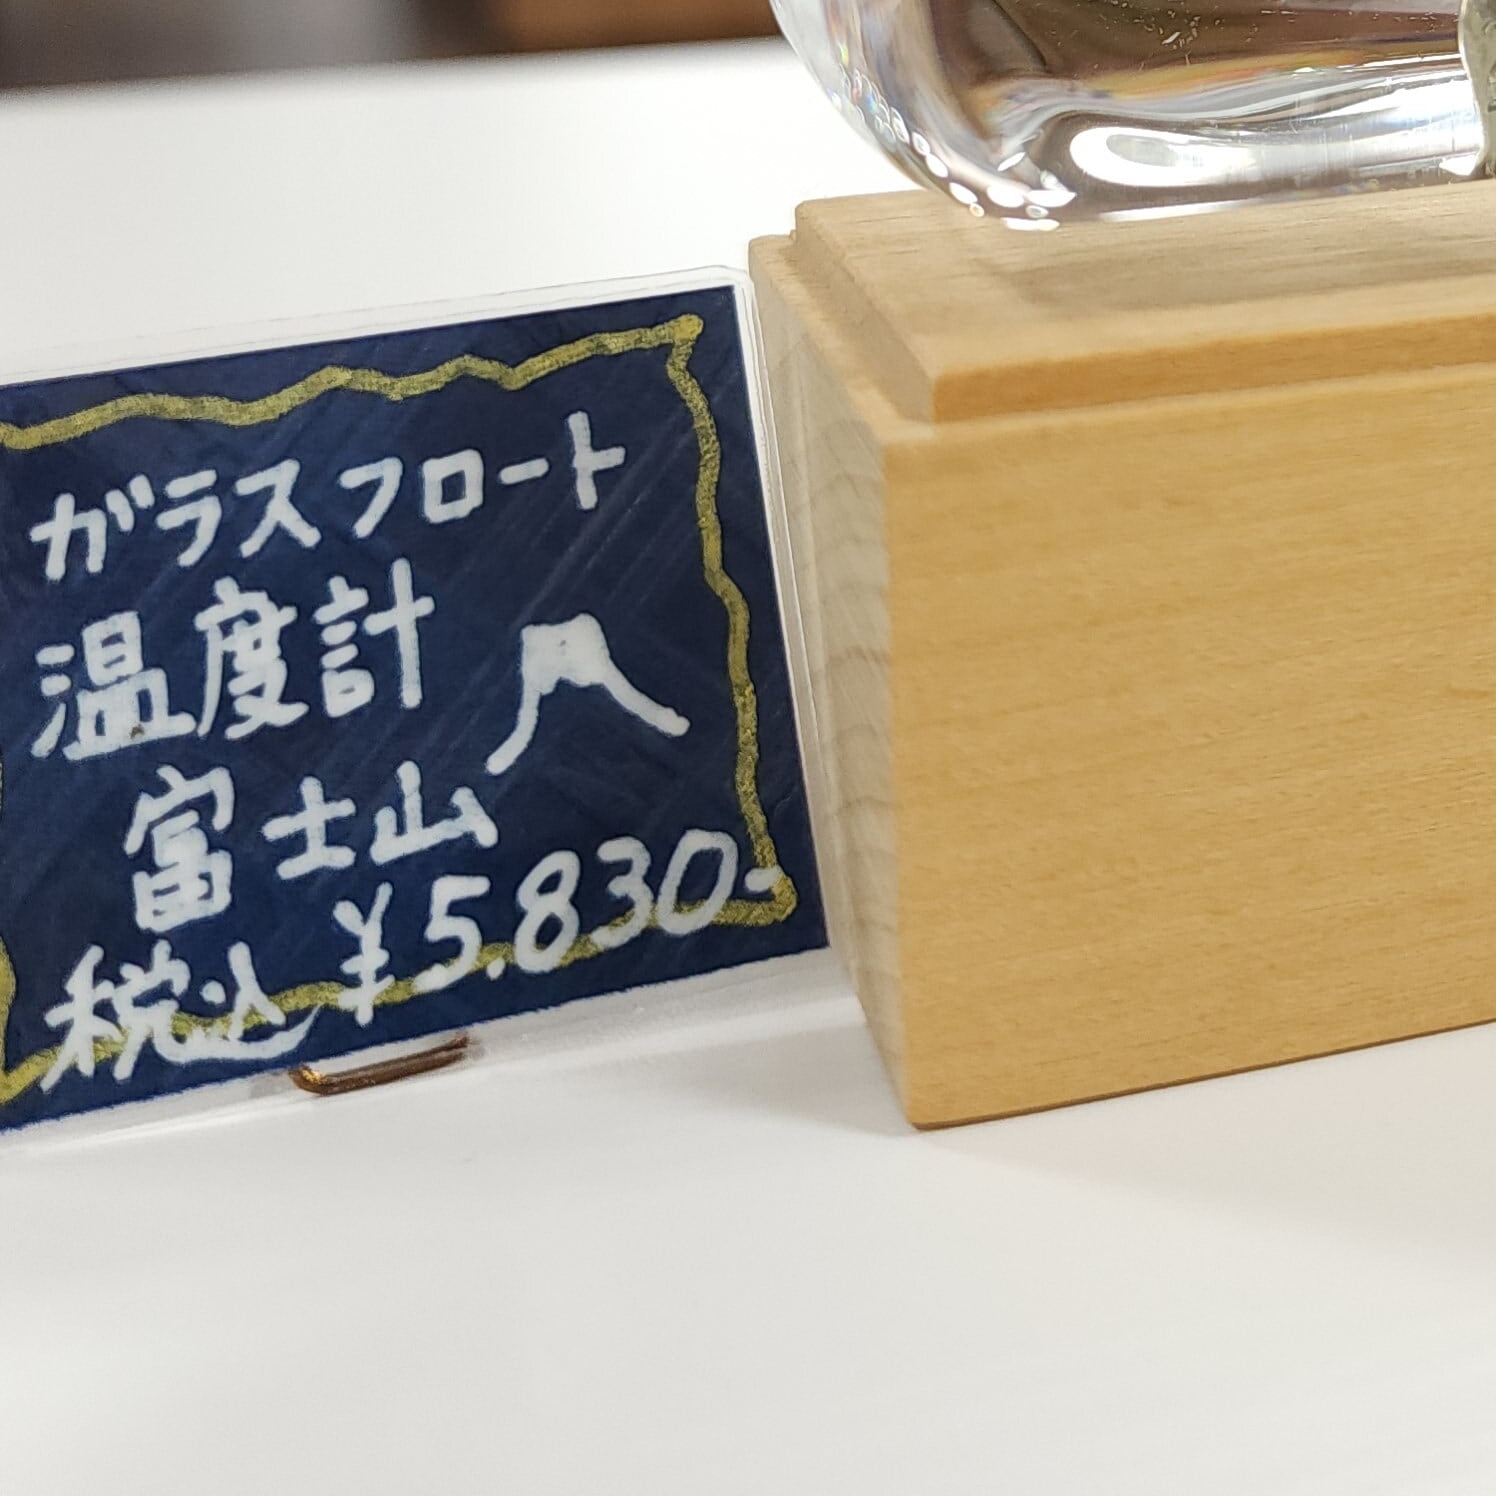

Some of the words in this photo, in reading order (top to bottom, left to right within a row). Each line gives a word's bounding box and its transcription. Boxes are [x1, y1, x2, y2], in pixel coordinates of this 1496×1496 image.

[31, 558, 436, 761] 温度計
[123, 761, 499, 933] 富士山
[39, 940, 322, 1093] 税込
